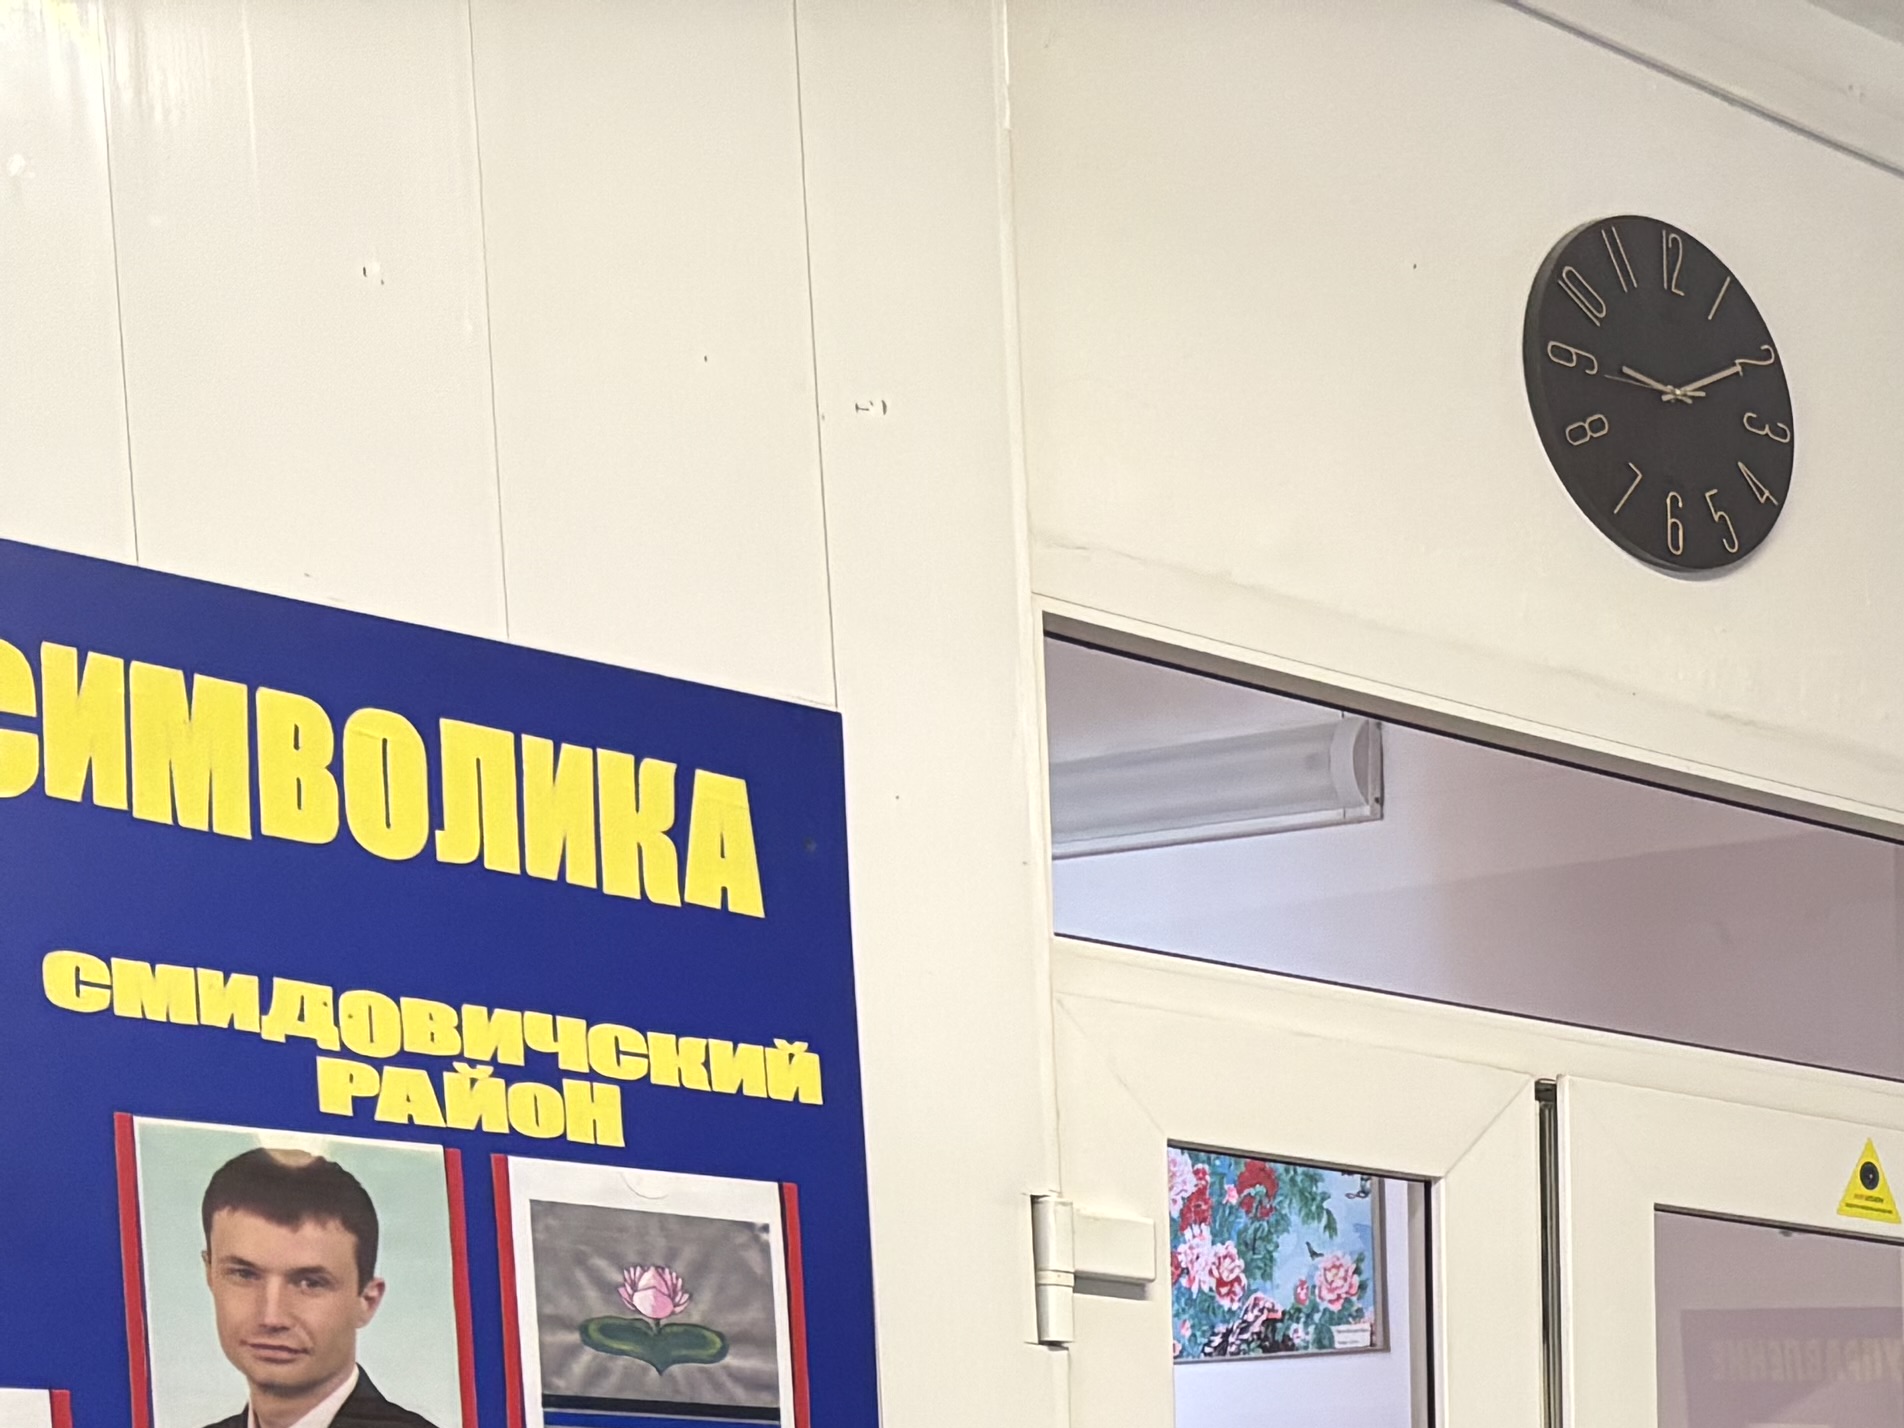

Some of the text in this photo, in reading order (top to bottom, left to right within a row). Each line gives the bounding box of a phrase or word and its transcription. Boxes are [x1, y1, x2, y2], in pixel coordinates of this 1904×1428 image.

[1602, 226, 1638, 293] 11
[1662, 229, 1684, 296] 12
[1557, 266, 1607, 326] 10
[1708, 276, 1731, 320] 1
[1547, 340, 1598, 375] 9
[1735, 344, 1775, 377] 2
[1566, 414, 1609, 445] 8
[1743, 412, 1790, 443] 3
[1614, 462, 1644, 514] 7
[1738, 461, 1778, 506] 4
[1666, 491, 1684, 555] 6
[1704, 489, 1739, 553] 5
[42, 950, 822, 1104] СМИДОВИЧСКИЙ
[317, 1055, 624, 1147] РАЙОН
